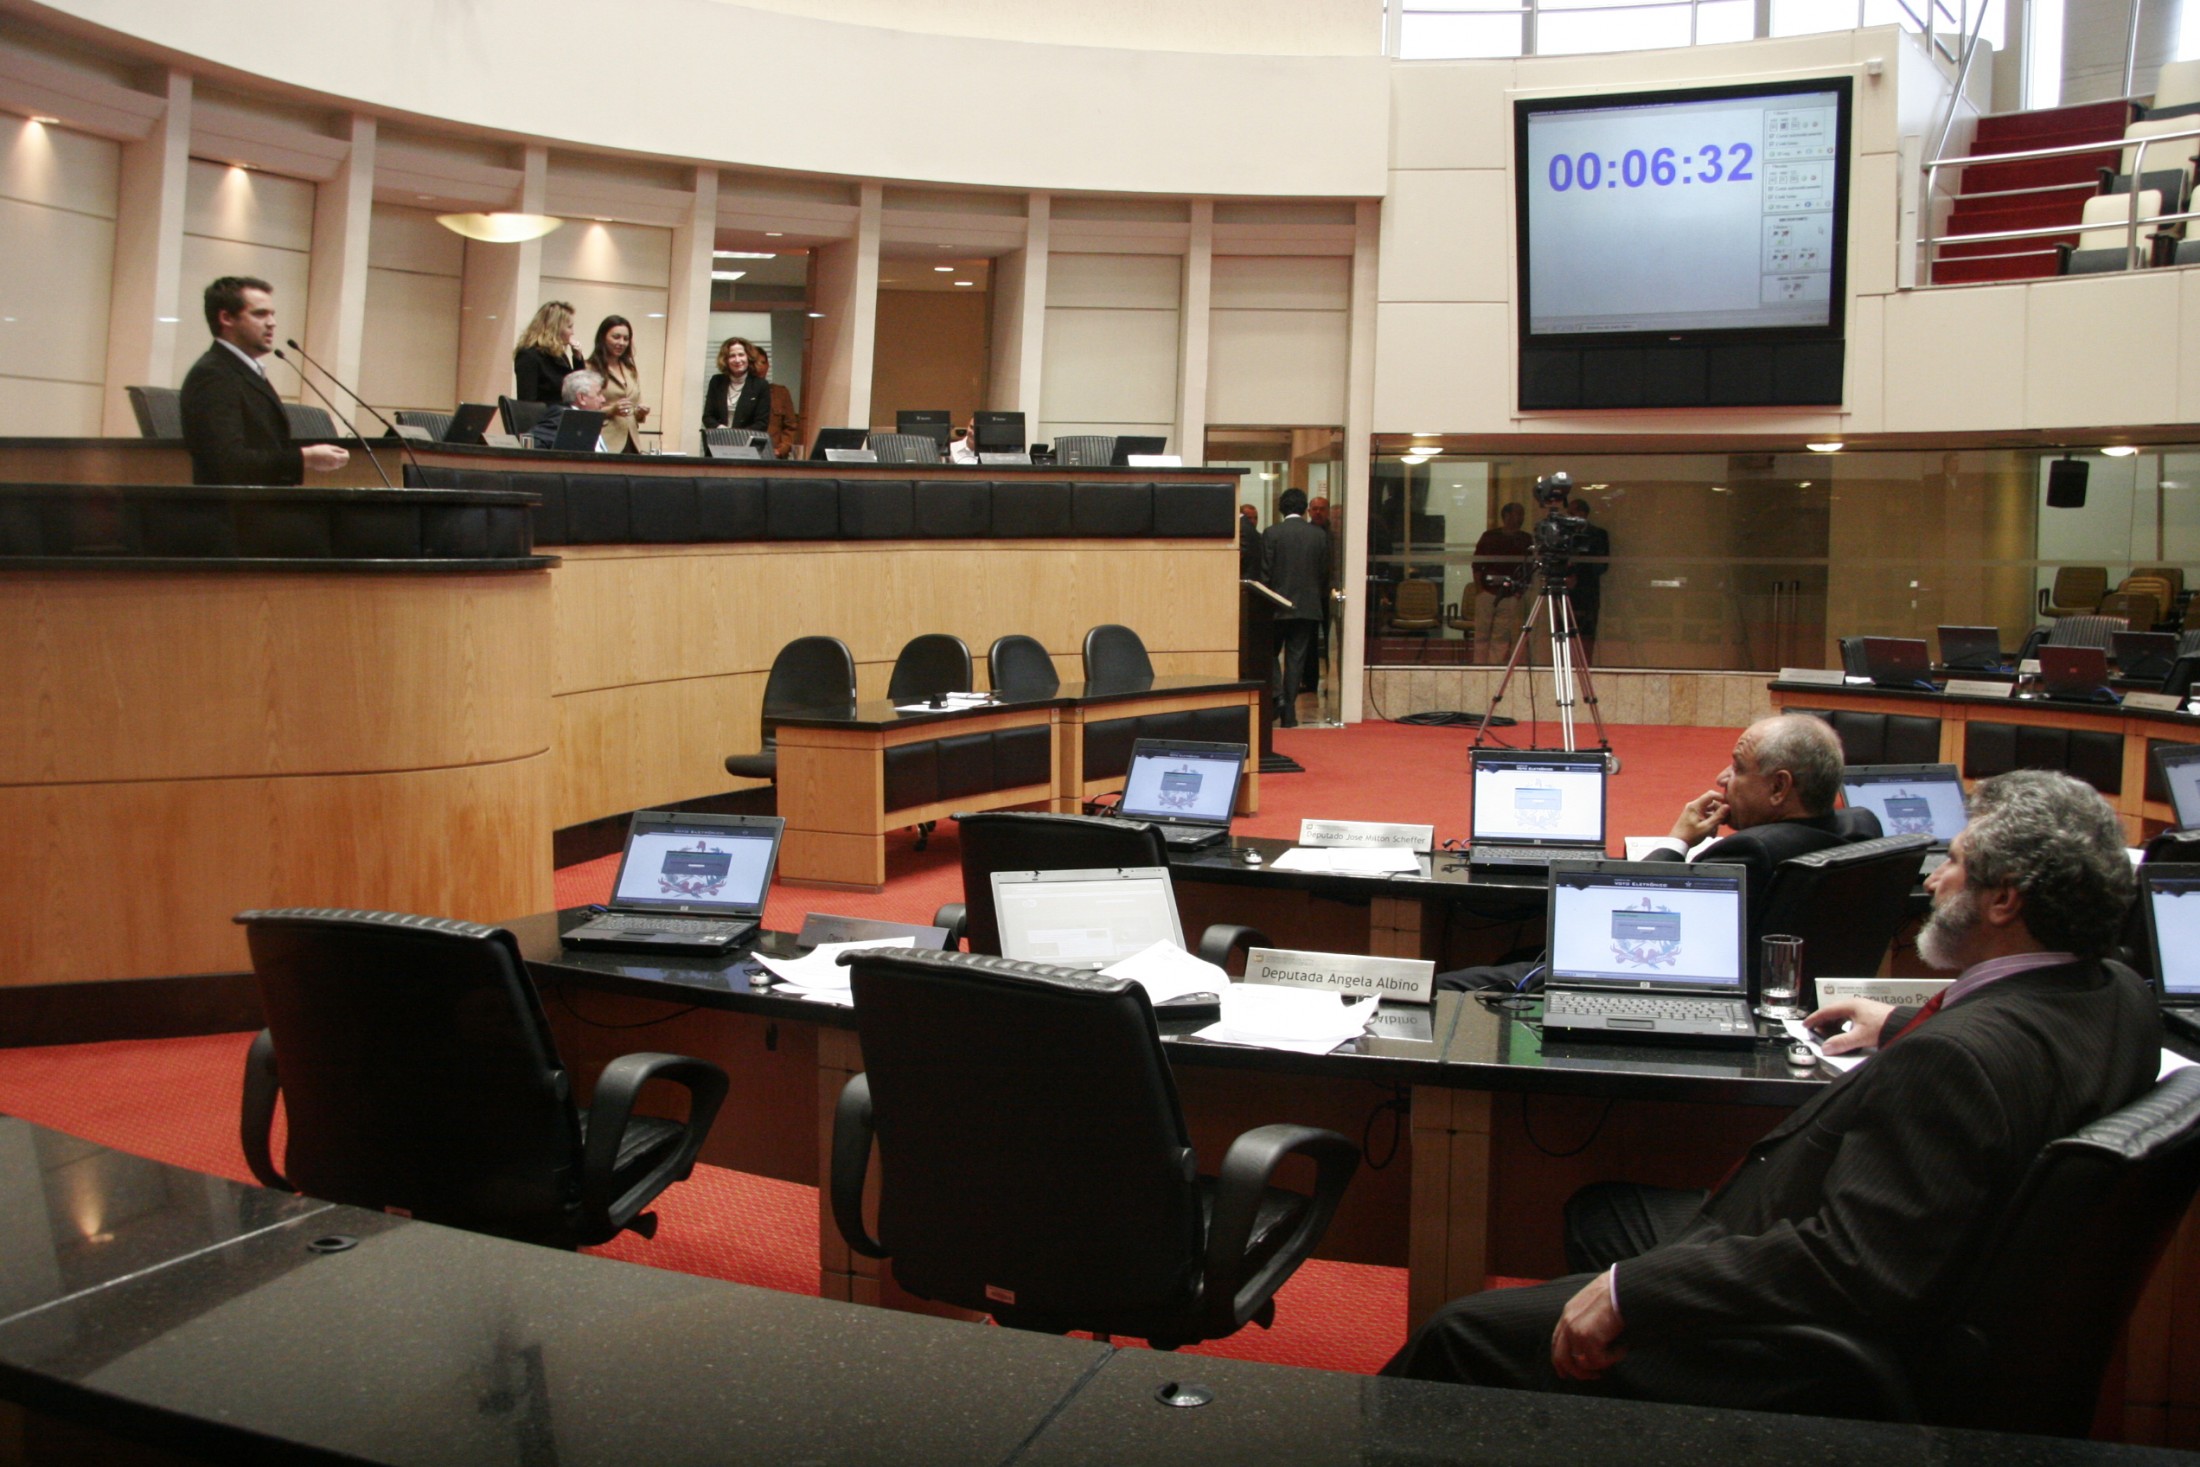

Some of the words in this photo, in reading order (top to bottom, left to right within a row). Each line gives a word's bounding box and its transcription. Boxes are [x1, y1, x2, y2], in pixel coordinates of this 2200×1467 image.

[1548, 142, 1753, 192] 00:06:32
[1392, 835, 1426, 845] Scheffer
[1262, 966, 1323, 982] Deputada
[1376, 976, 1419, 992] Albino
[1853, 994, 1913, 1004] utado
